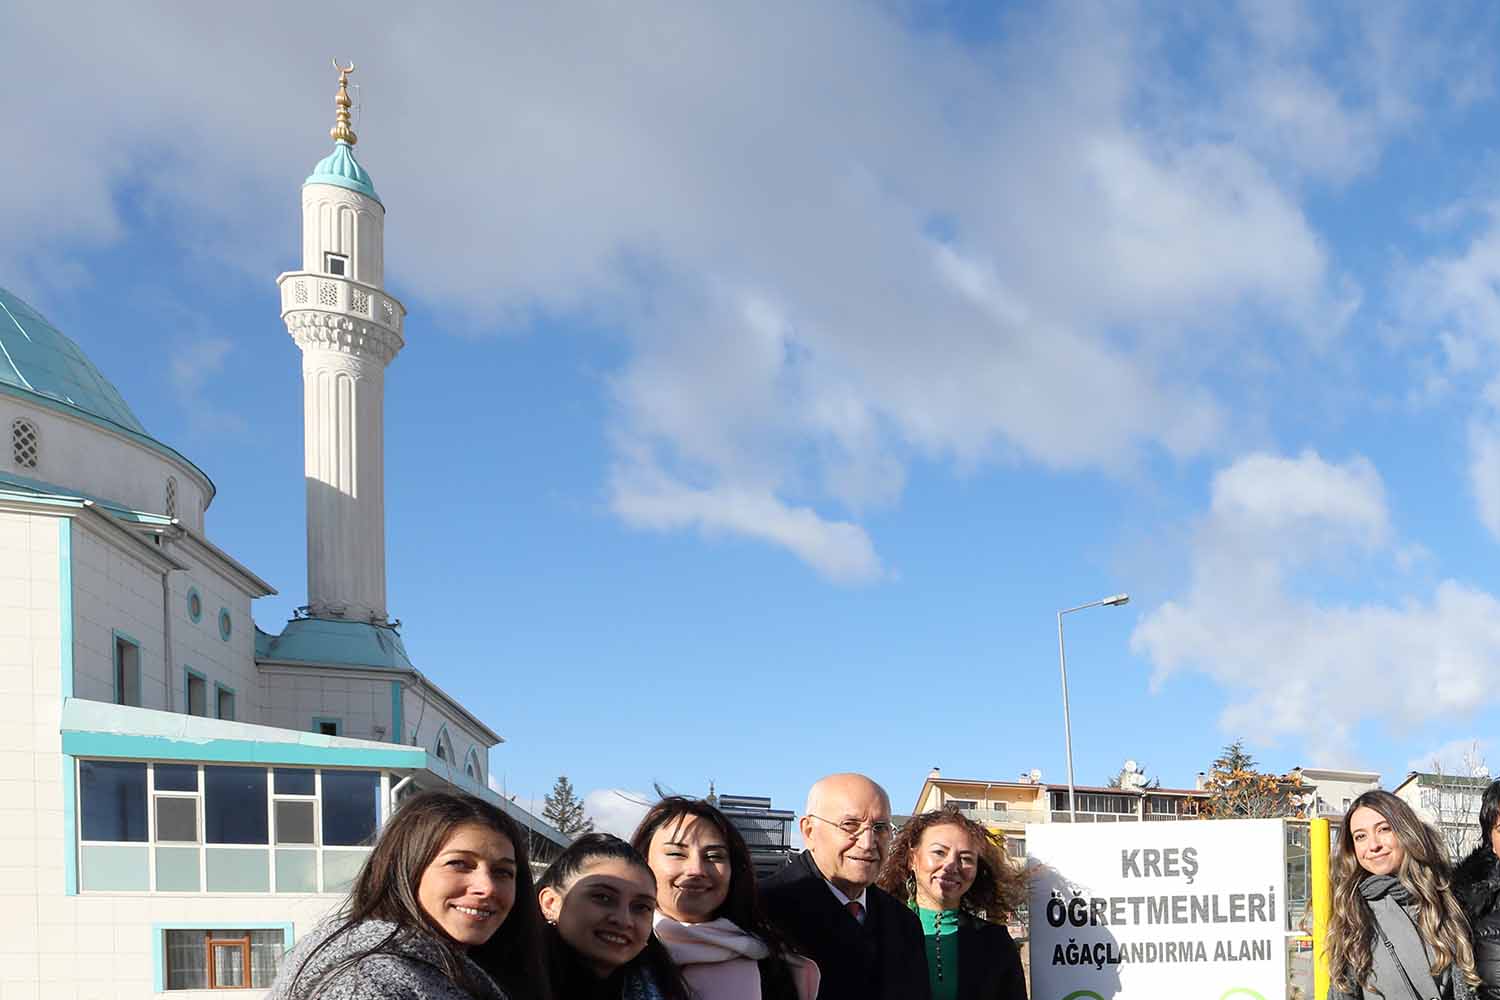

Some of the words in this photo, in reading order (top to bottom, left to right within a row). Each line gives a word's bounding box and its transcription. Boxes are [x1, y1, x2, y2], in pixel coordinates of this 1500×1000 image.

[1122, 847, 1199, 885] KREŞ
[1047, 886, 1276, 928] ÖĞRETMENLERİ
[1052, 939, 1207, 970] AĞAÇLANDIRMA
[1214, 939, 1271, 962] ALANI
